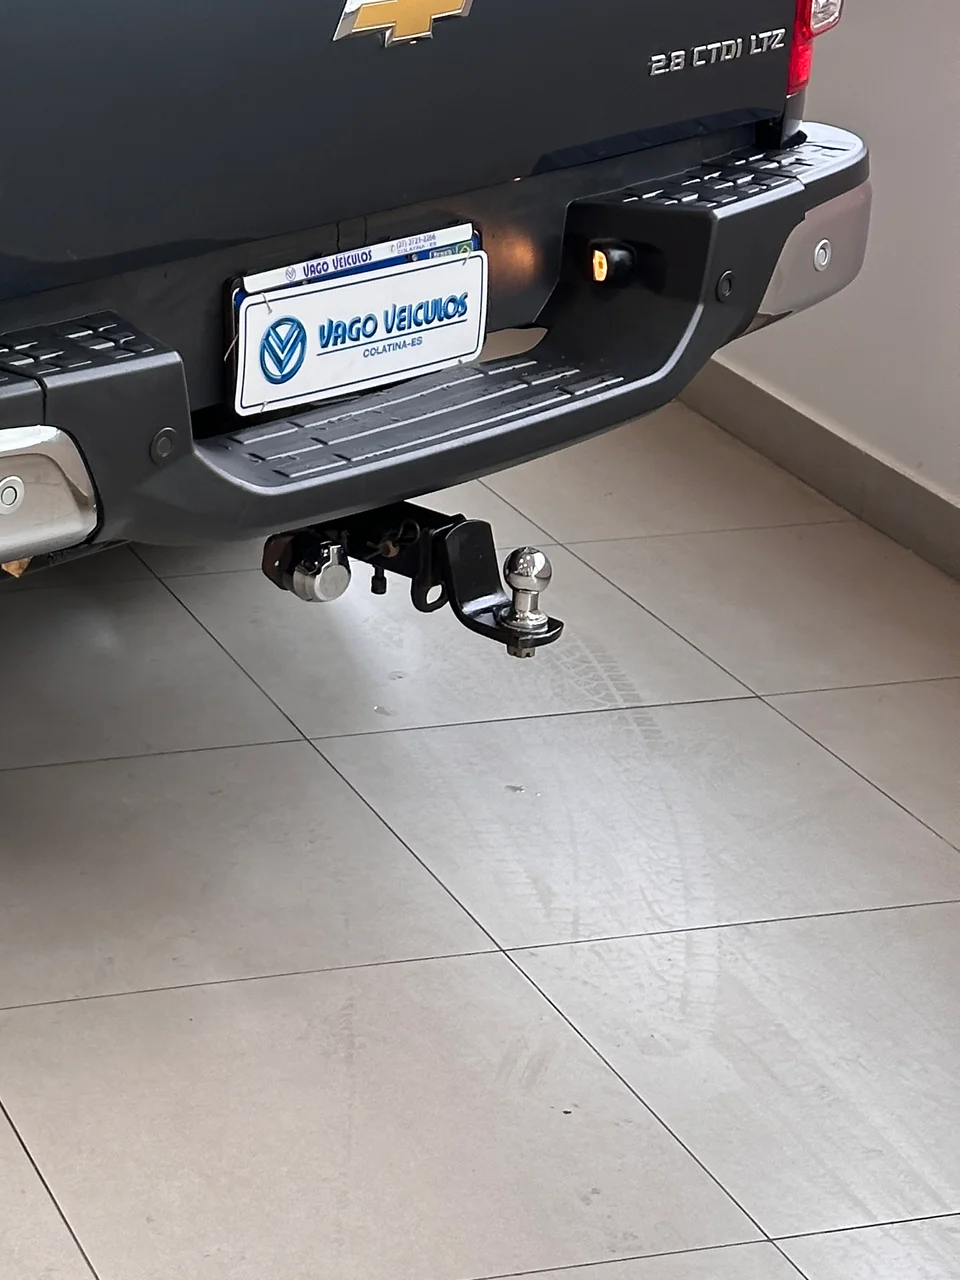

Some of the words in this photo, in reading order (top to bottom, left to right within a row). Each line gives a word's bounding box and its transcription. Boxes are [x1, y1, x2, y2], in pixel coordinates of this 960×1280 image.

[749, 28, 787, 55] LTZ
[303, 262, 329, 277] VAGO
[318, 313, 378, 349] VAGO
[384, 292, 468, 334] VEICULOS
[362, 335, 424, 359] COLATINA-ES
